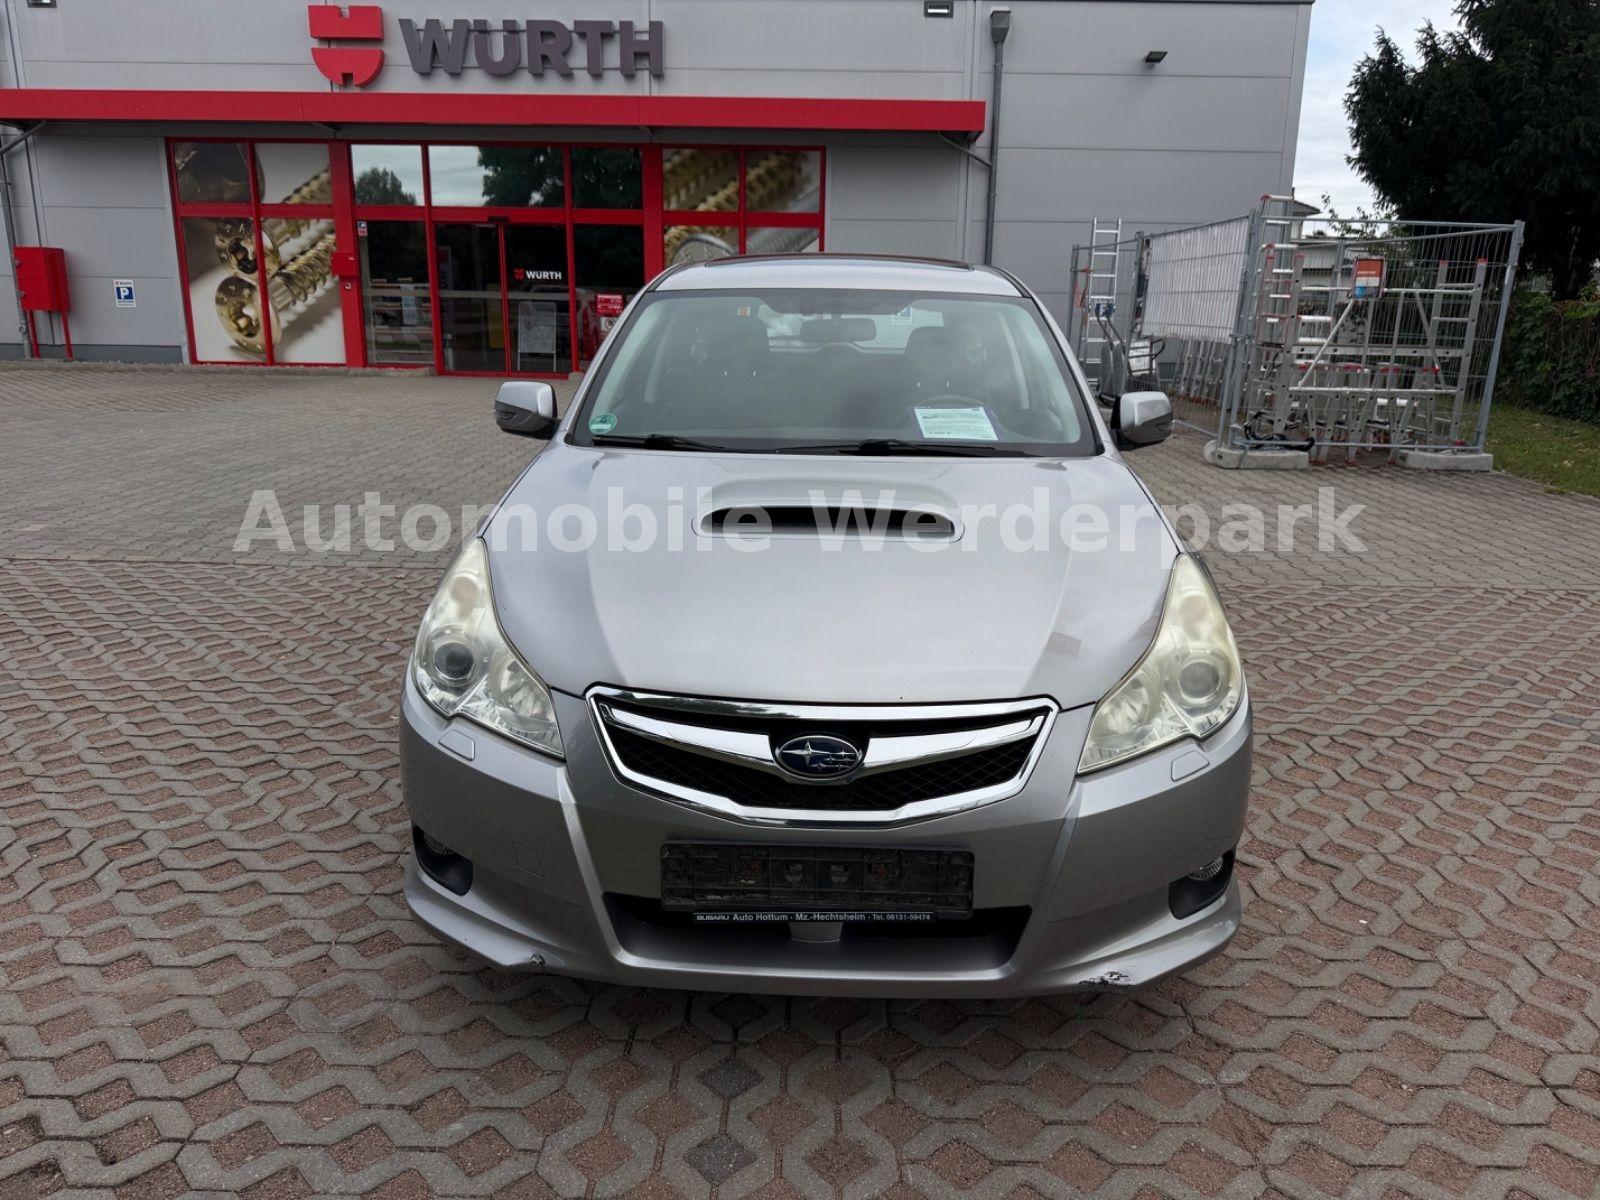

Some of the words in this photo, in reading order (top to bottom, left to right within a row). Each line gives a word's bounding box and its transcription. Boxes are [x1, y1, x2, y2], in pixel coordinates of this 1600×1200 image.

[398, 18, 664, 78] WÜRTH
[120, 287, 130, 299] P
[733, 913, 754, 921] Auto
[872, 913, 884, 921] Tel.
